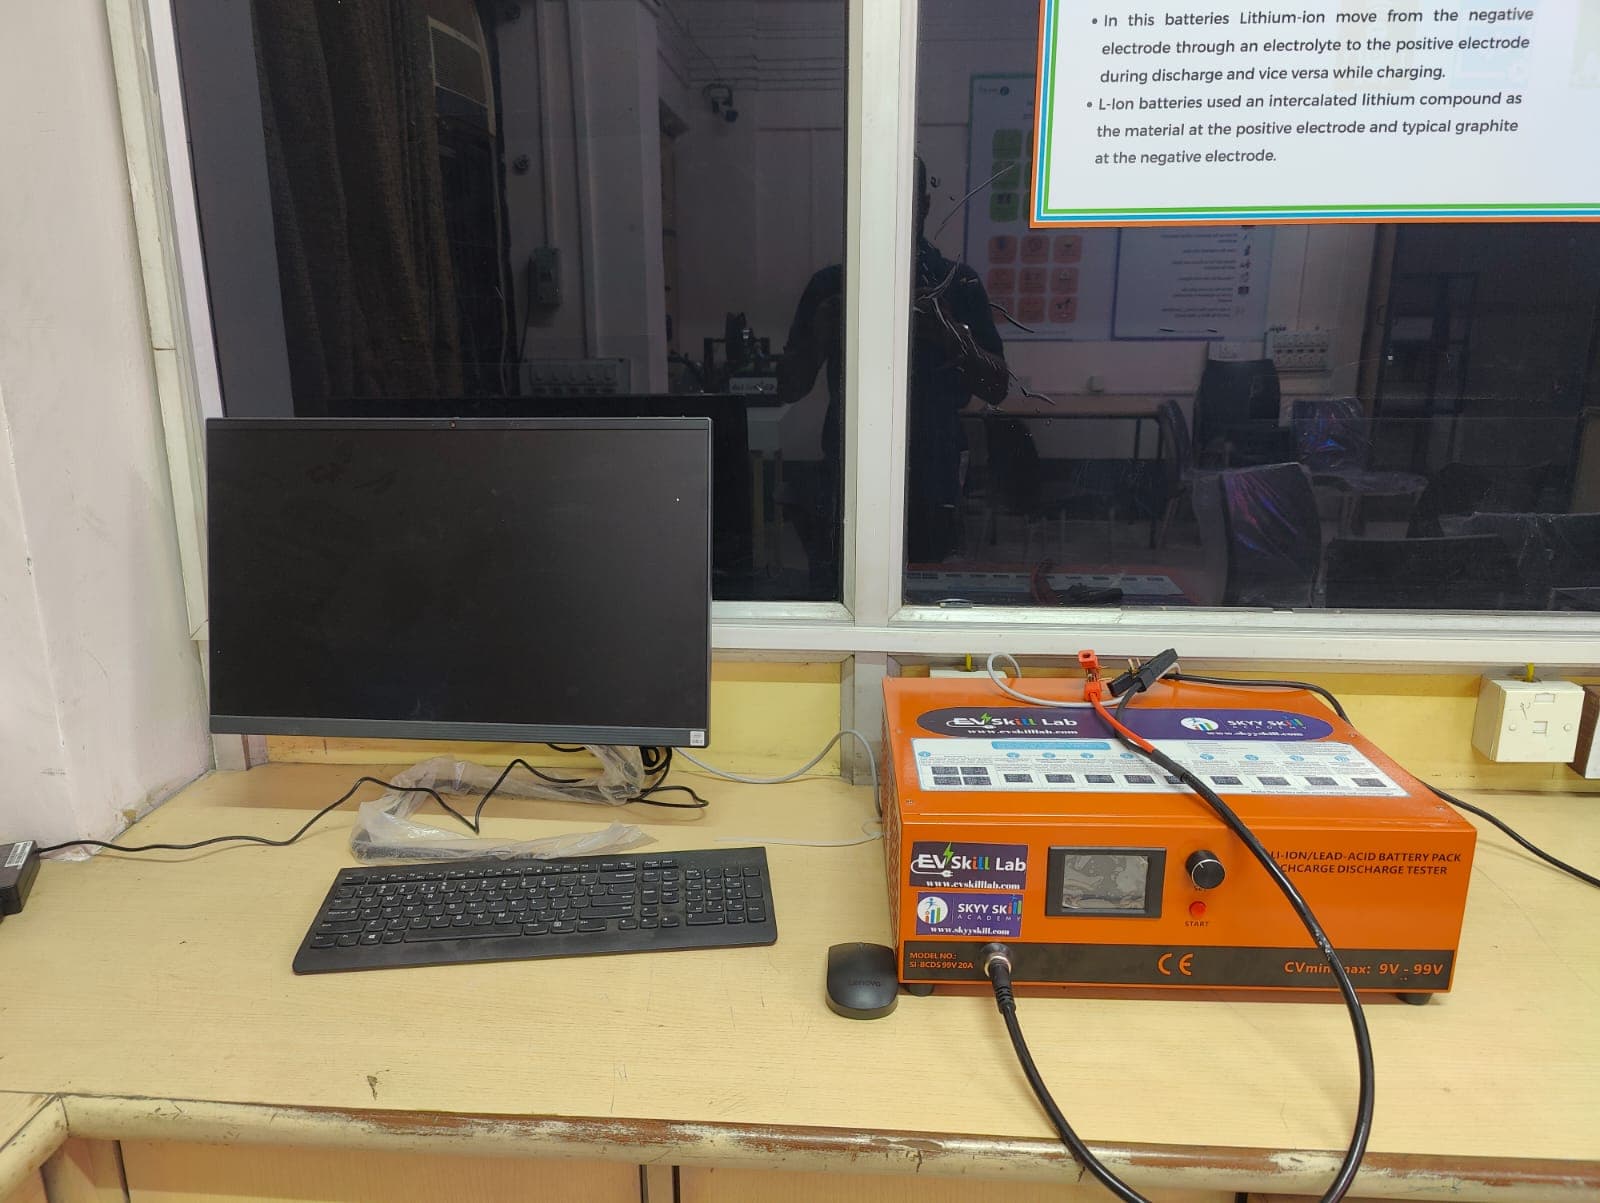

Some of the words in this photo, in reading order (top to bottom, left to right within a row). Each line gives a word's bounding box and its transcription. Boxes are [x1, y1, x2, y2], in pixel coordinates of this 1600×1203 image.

[1105, 14, 1117, 26] In
[1128, 13, 1155, 26] this
[1165, 12, 1230, 25] batteries
[1240, 10, 1326, 24] Lithium-ion
[1336, 12, 1377, 23] move
[1388, 9, 1423, 22] from
[1434, 9, 1459, 21] the
[1469, 7, 1534, 24] negative
[1102, 40, 1171, 54] electrode
[1176, 39, 1235, 56] through
[1240, 42, 1259, 53] an
[1264, 38, 1342, 55] electrolyte
[1347, 39, 1362, 51] to
[1367, 37, 1392, 50] the
[1396, 37, 1454, 53] positive
[1459, 36, 1530, 50] electrode
[1101, 69, 1147, 85] during
[1152, 68, 1222, 84] discharge
[1227, 67, 1254, 81] and
[1259, 66, 1287, 79] vice
[1292, 69, 1328, 79] versa
[1333, 65, 1373, 78] while
[1377, 65, 1446, 81] charging.
[1139, 95, 1202, 110] batteries
[1208, 94, 1241, 108] used
[1246, 97, 1264, 108] an
[1269, 93, 1358, 107] intercalated
[1362, 92, 1415, 106] lithium
[1420, 91, 1502, 108] compound
[1506, 94, 1523, 105] as
[1097, 124, 1120, 138] the
[1125, 123, 1184, 137] material
[1189, 123, 1203, 136] at
[1208, 122, 1231, 135] the
[1236, 121, 1292, 138] positive
[1296, 120, 1365, 134] electrode
[1370, 119, 1398, 133] and
[1403, 119, 1451, 136] typical
[1456, 119, 1519, 135] graphite
[1095, 153, 1109, 164] at
[1114, 151, 1136, 164] the
[1141, 150, 1201, 167] negative
[1206, 148, 1277, 163] electrode.
[1042, 718, 1078, 726] Lab
[995, 857, 1027, 872] Lab
[1379, 852, 1430, 862] BATTERY
[1431, 853, 1461, 863] PACK
[1337, 864, 1404, 874] DISCHARGE
[1406, 865, 1447, 875] TESTER
[926, 880, 1020, 890] www.evskilllab.com
[957, 903, 989, 914] SKYY
[957, 914, 1022, 922] ACADEMY
[930, 926, 1010, 936] www.skyyskill.com
[909, 952, 937, 960] MODEL
[1158, 953, 1194, 976] CE
[1379, 961, 1399, 975] 9V
[1413, 962, 1444, 976] 99V
